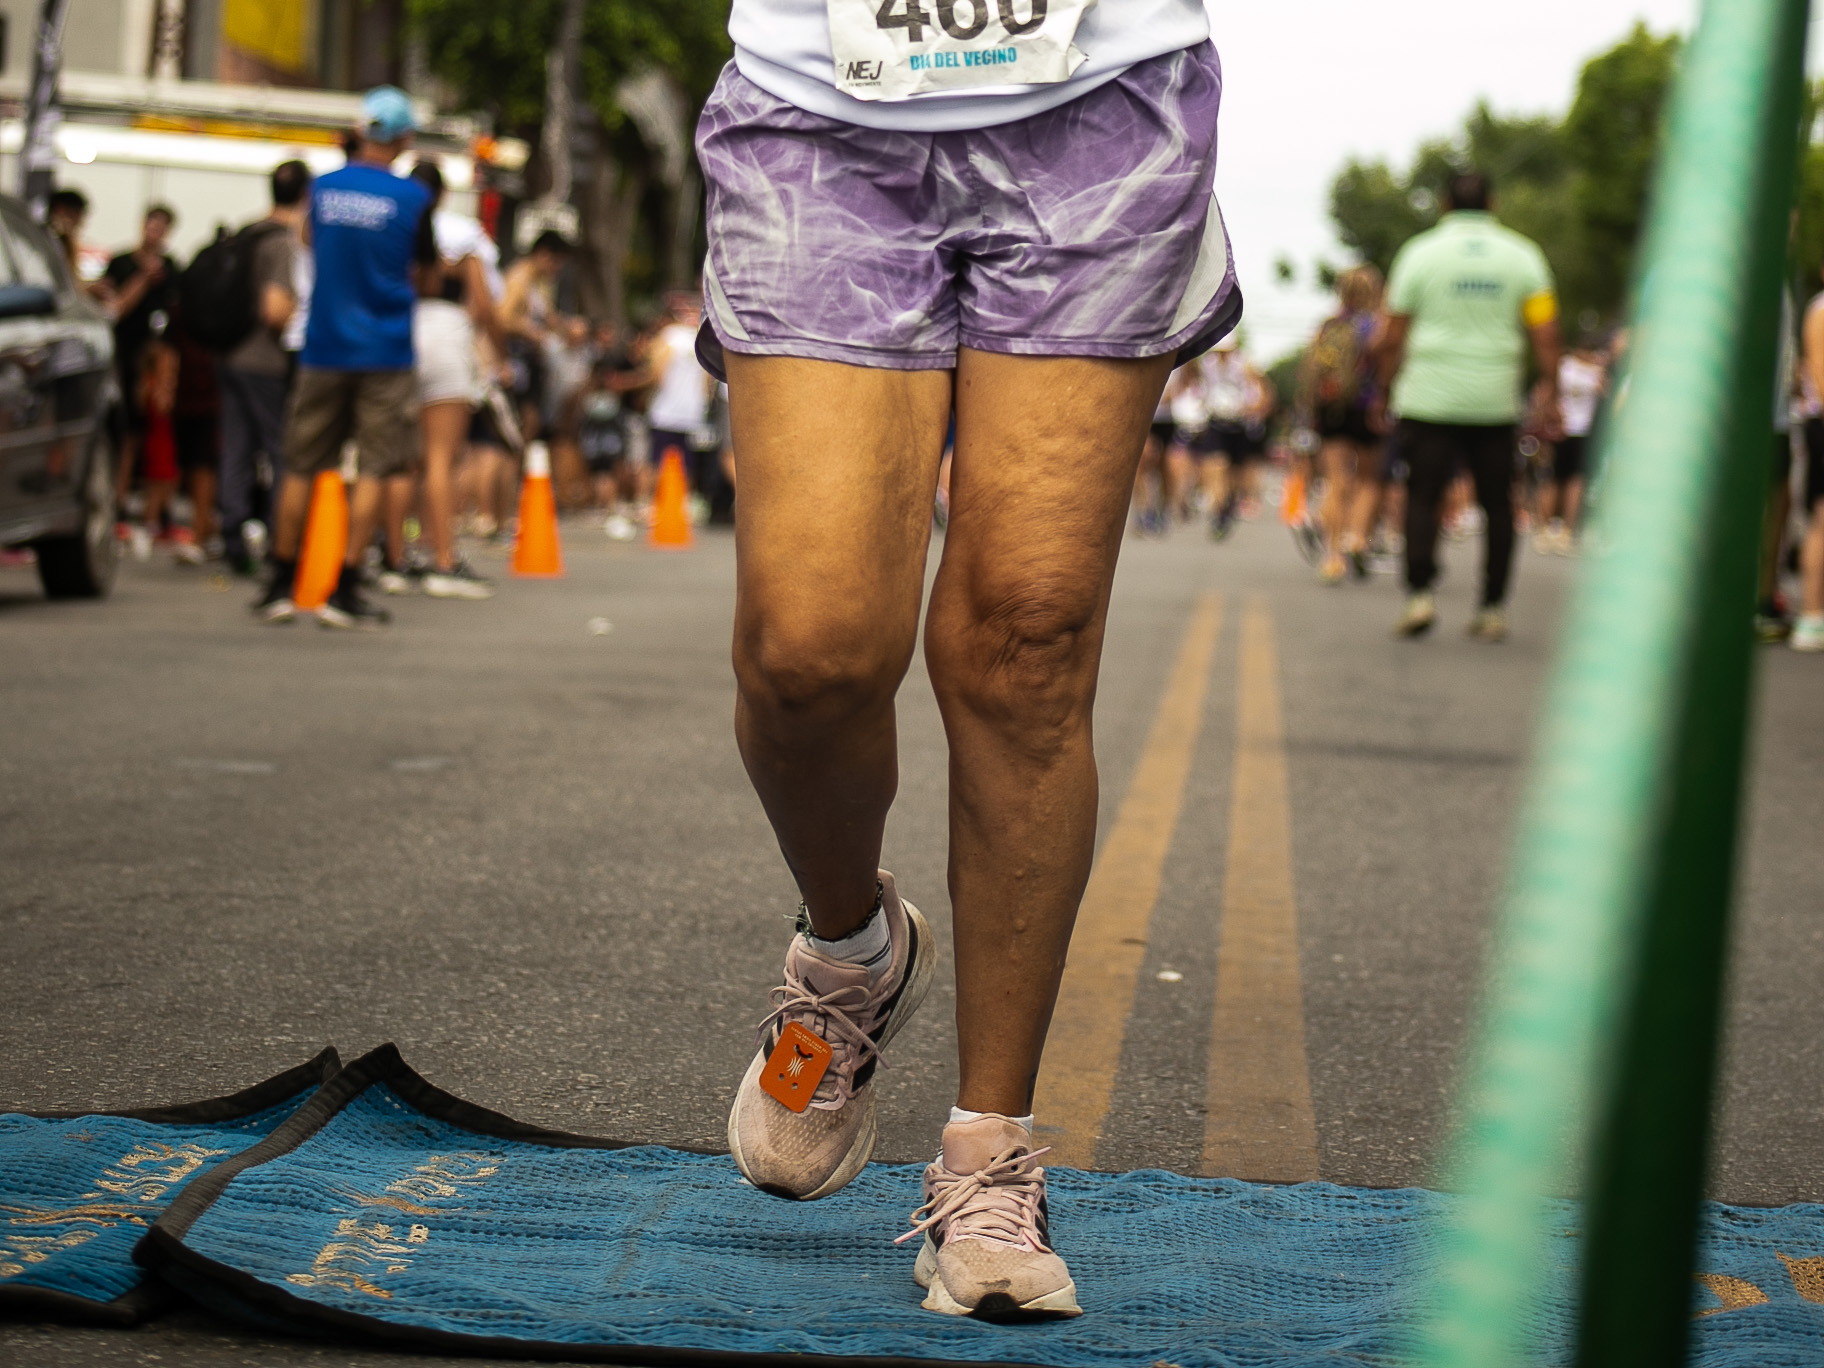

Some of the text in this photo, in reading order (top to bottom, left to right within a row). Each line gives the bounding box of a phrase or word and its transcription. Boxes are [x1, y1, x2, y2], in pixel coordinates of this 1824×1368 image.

[935, 51, 960, 68] DEL
[963, 47, 1017, 67] VECINO
[846, 60, 883, 81] NEJ
